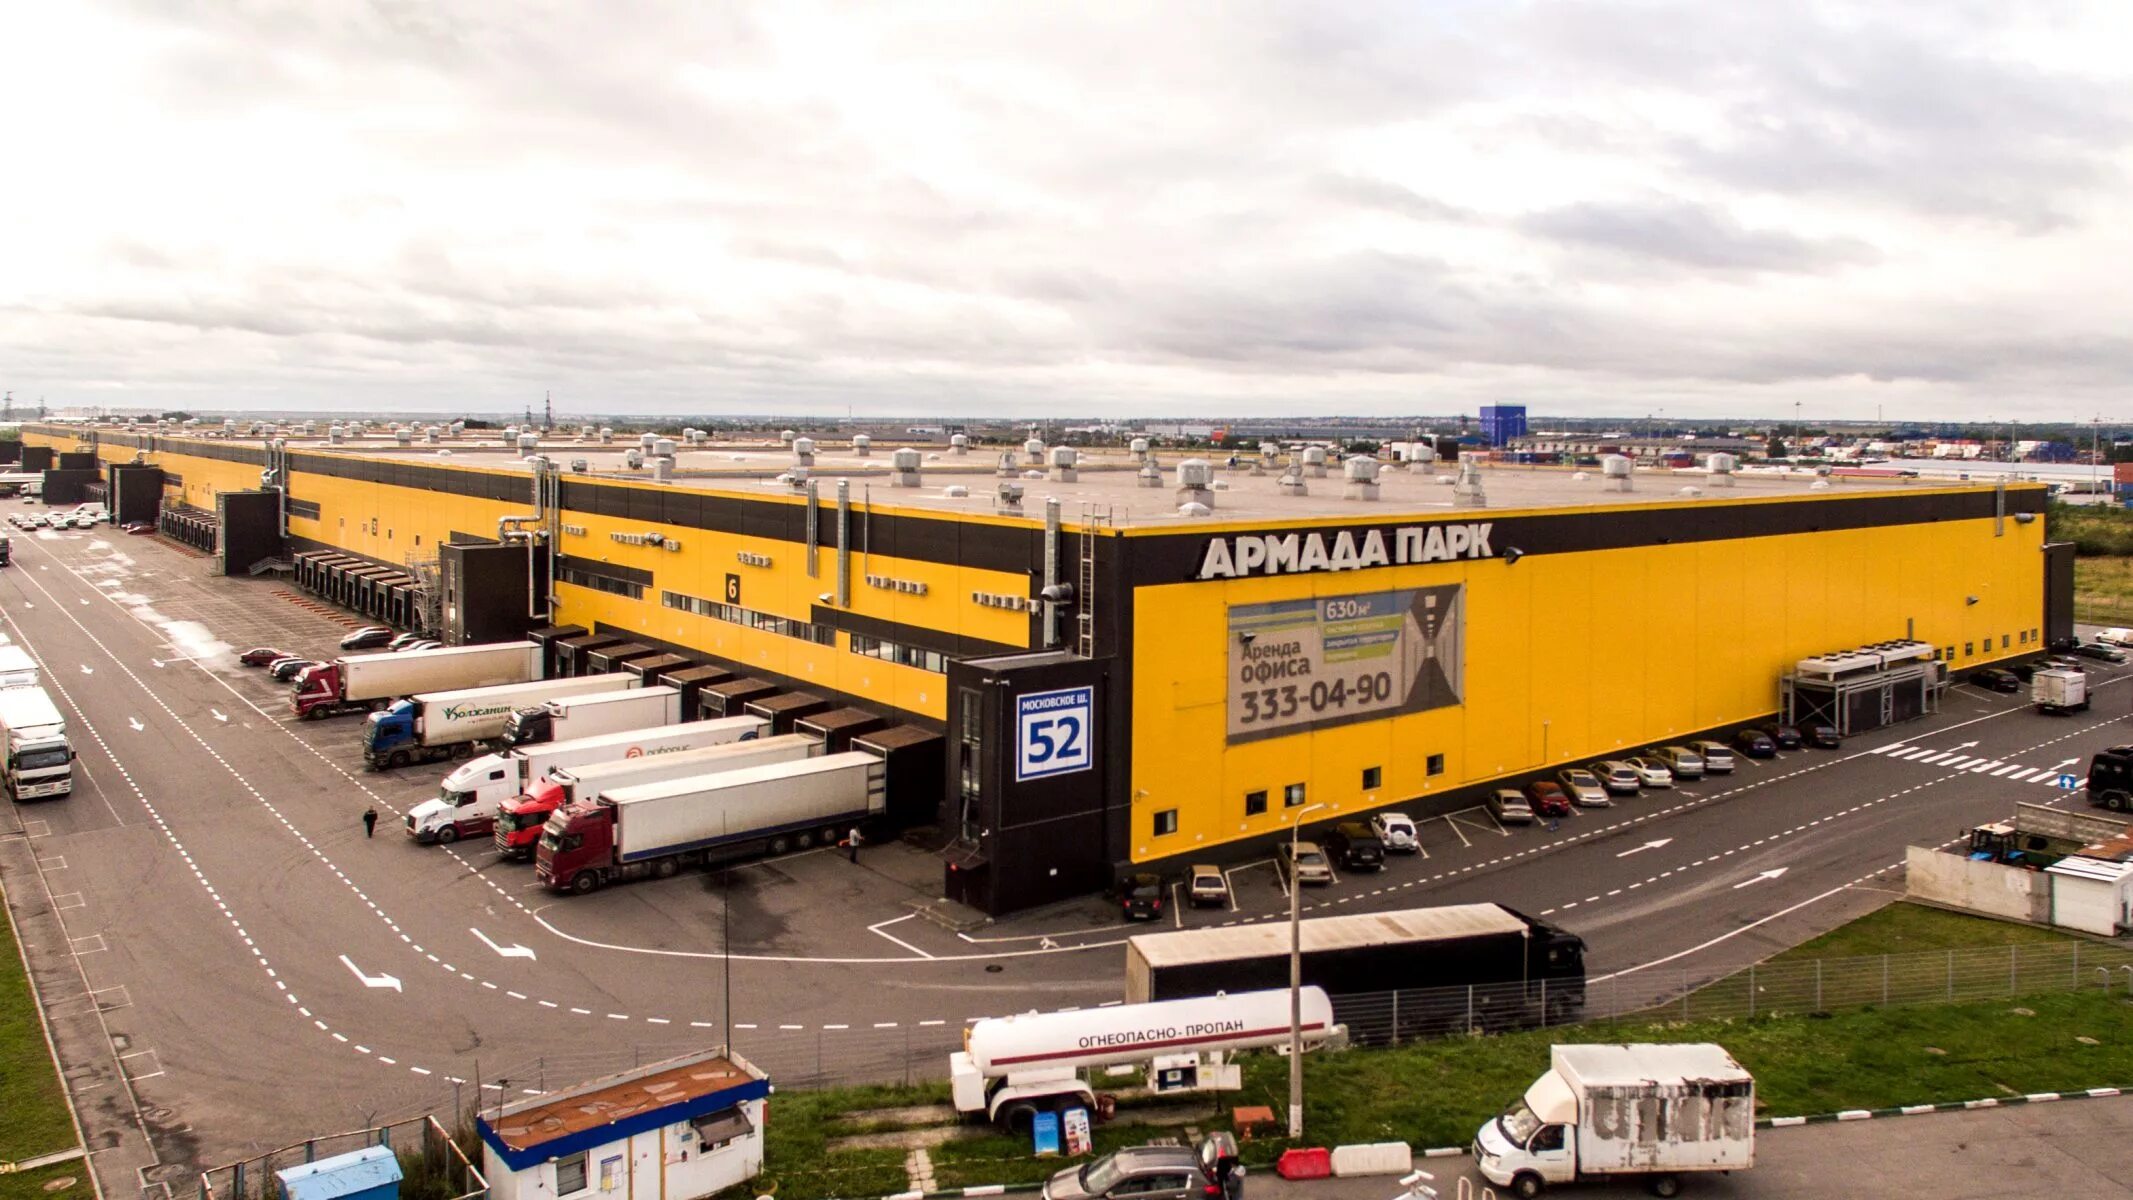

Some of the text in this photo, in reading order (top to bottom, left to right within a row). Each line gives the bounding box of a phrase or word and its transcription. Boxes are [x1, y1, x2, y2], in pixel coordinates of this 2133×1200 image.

[1201, 523, 1493, 579] АРМАДА ПАРК
[728, 579, 737, 599] 6
[1326, 600, 1357, 619] 630
[1241, 641, 1301, 663] Аренда
[1240, 657, 1311, 684] офиса
[1022, 694, 1076, 711] МОСКОВСКОЕ
[1240, 671, 1391, 724] 333-04-90
[1028, 716, 1082, 764] 52
